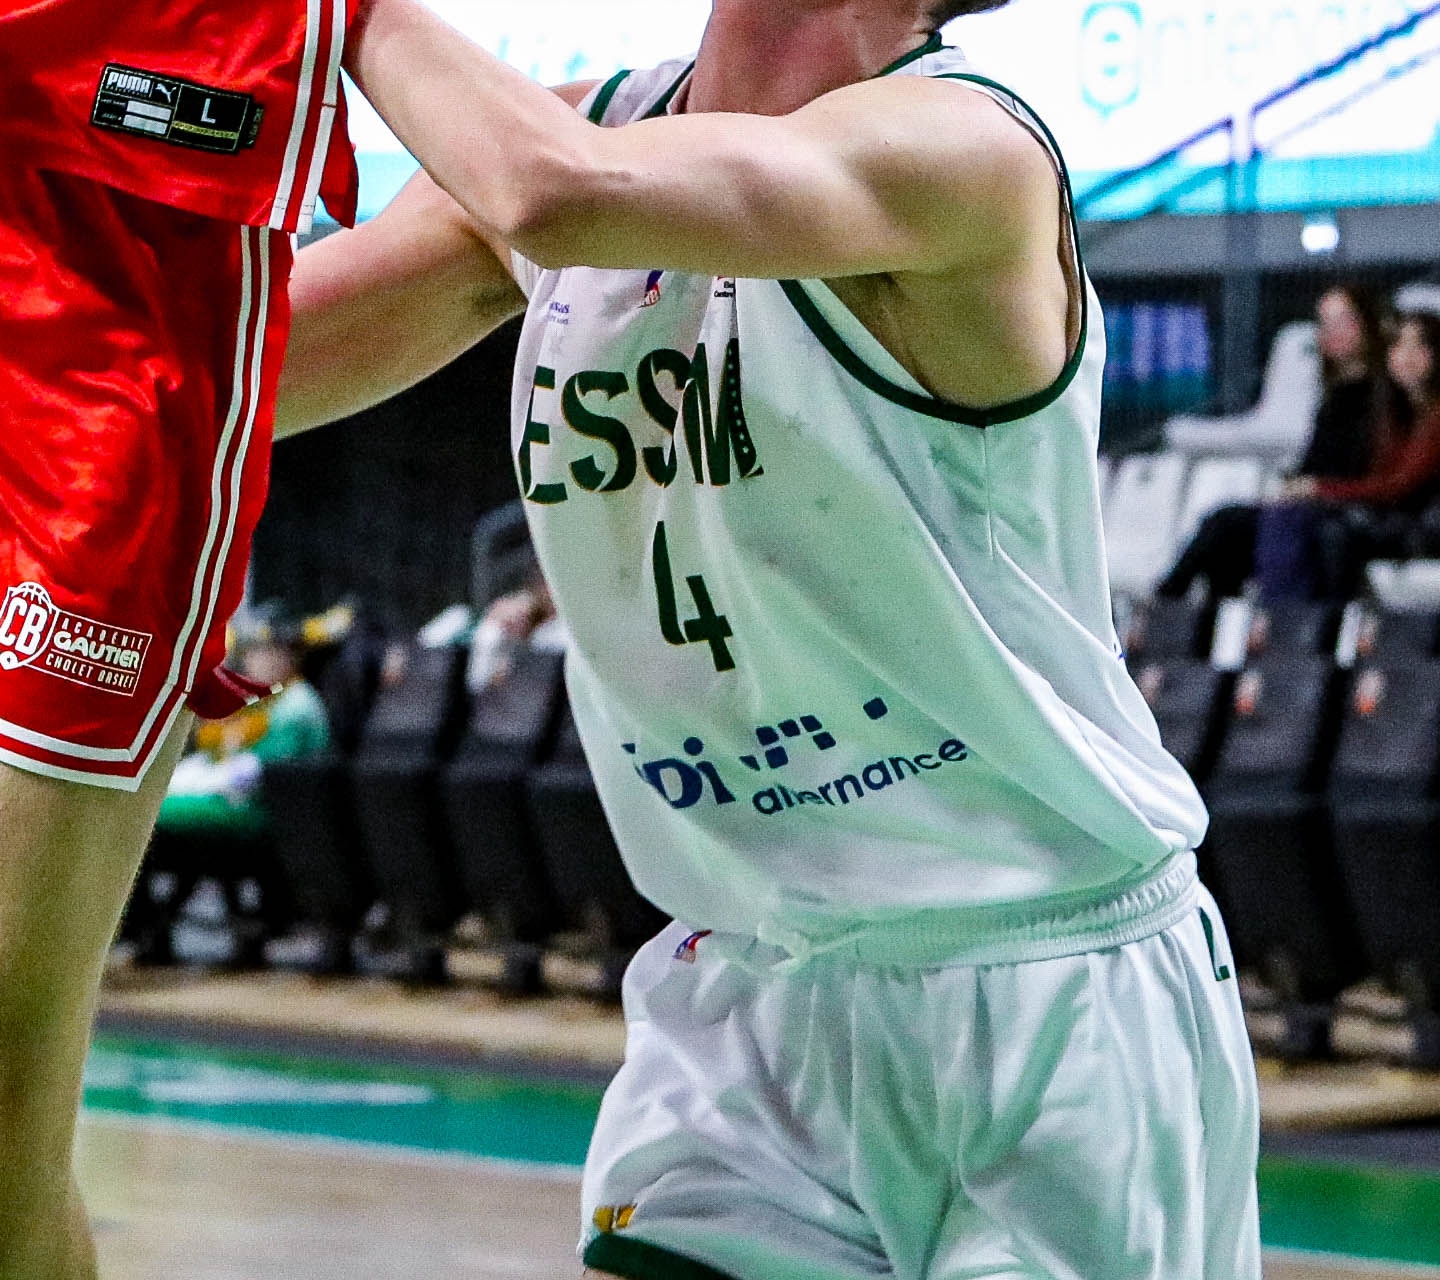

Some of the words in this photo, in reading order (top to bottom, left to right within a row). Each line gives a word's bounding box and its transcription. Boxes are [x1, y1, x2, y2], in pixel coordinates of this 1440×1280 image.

[106, 71, 152, 94] PUMA
[200, 97, 217, 125] L
[519, 337, 765, 505] ESSM
[652, 520, 736, 672] 4
[53, 630, 140, 670] GAUTIER
[45, 652, 94, 678] CHOLET
[97, 669, 135, 689] BASKET
[752, 738, 968, 815] alternance
